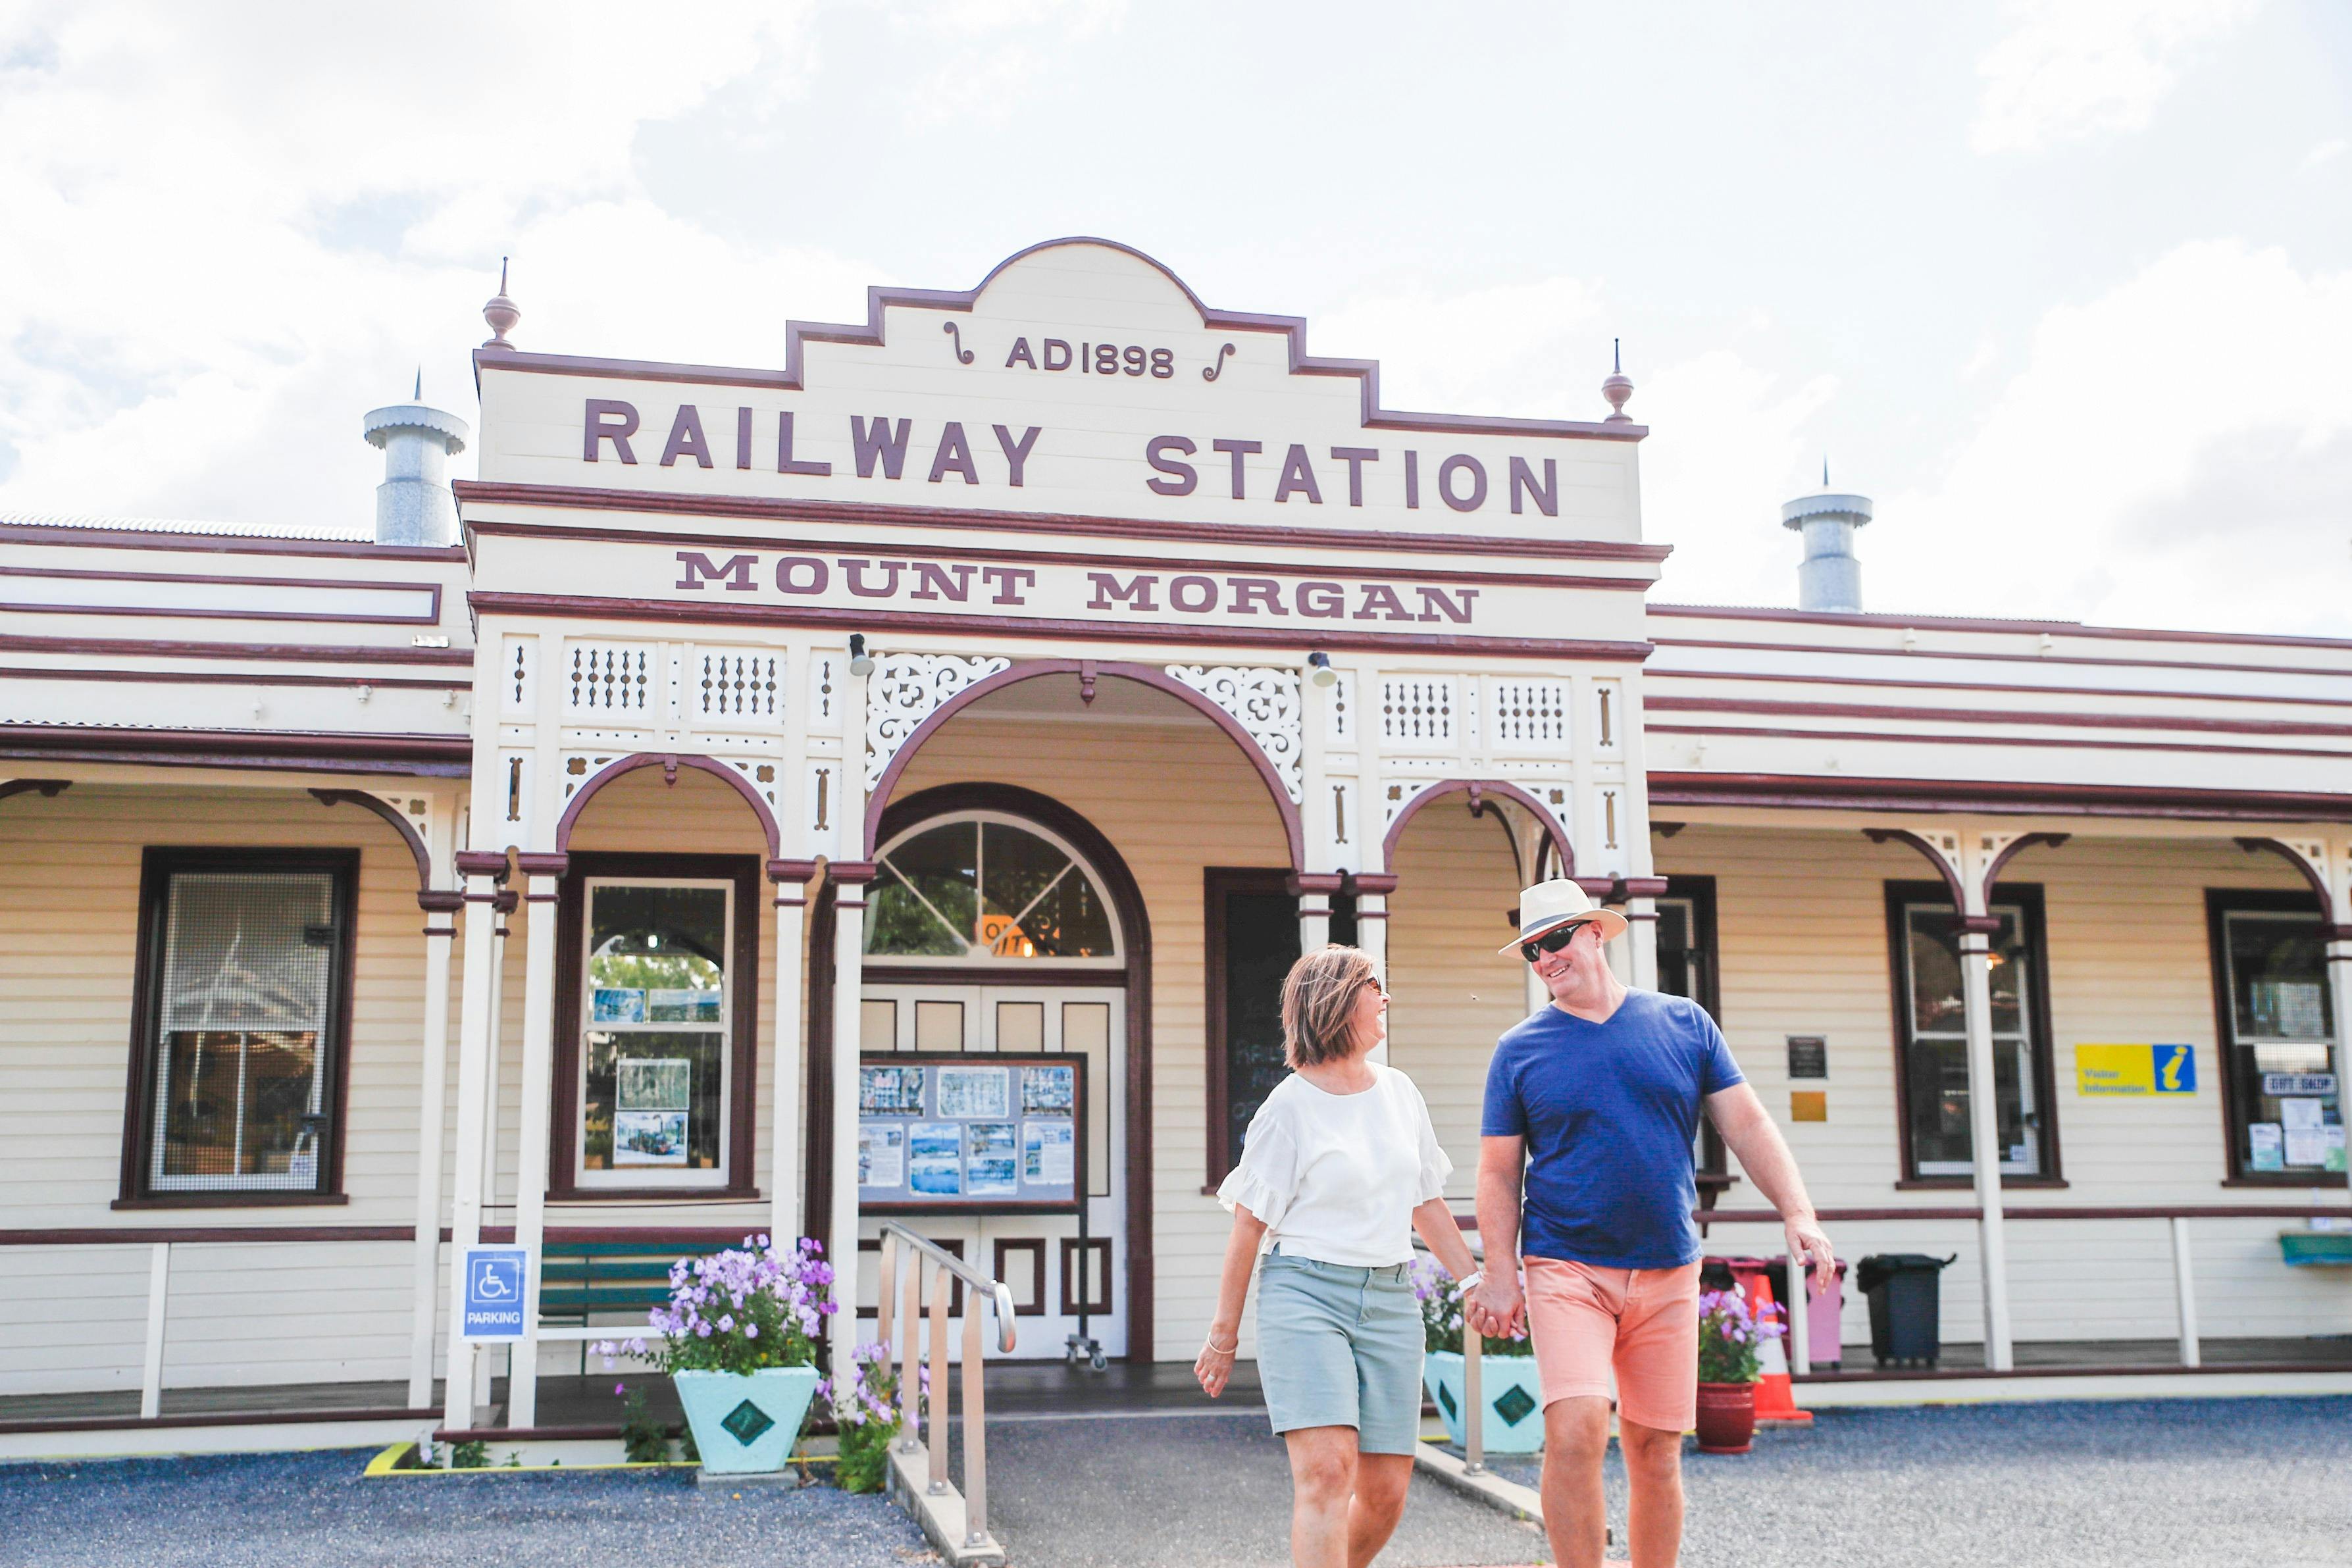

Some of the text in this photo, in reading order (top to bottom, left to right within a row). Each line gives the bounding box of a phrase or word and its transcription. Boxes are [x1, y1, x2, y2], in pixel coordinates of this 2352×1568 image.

[583, 398, 1558, 517] RAILWAY STATION
[675, 551, 1479, 624] MOUNT MORGAN
[2084, 1069, 2119, 1079] Visitor
[2084, 1085, 2147, 1094] Information
[467, 1311, 521, 1325] PARKING
